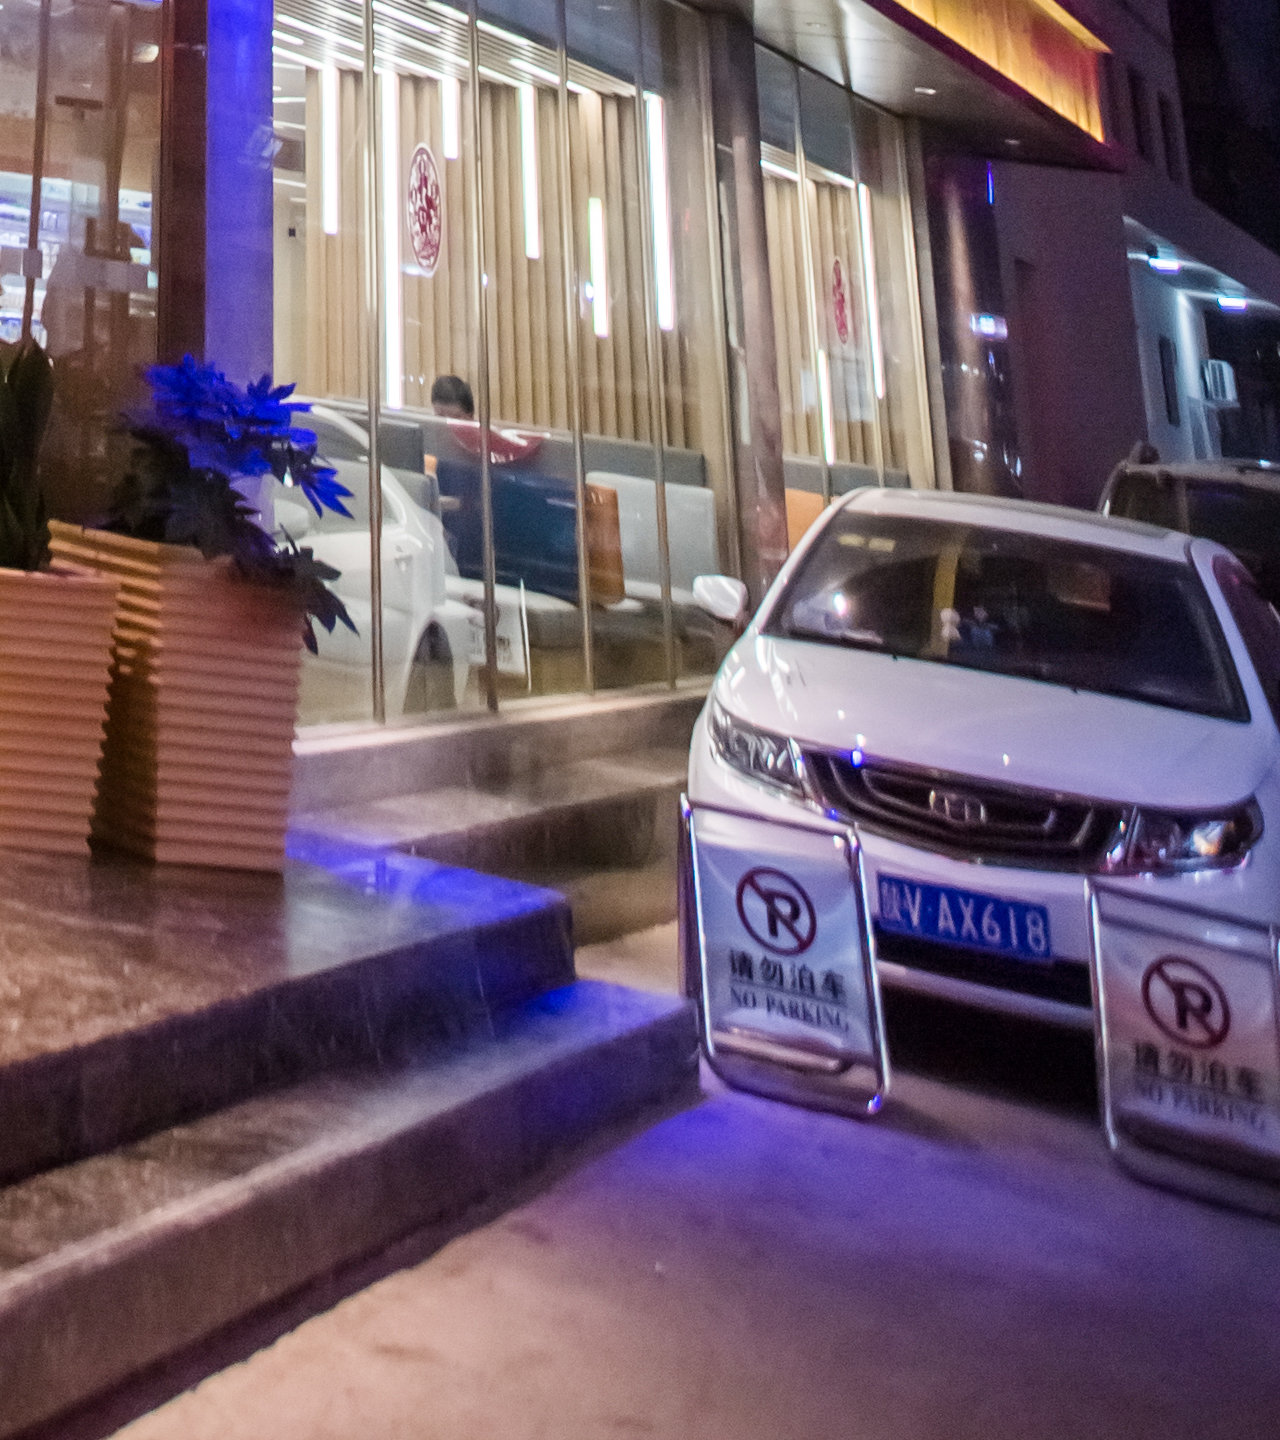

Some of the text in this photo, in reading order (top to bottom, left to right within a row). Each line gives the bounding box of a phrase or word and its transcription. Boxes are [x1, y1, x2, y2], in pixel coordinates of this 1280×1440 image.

[730, 949, 845, 1001] 请勿泊车
[730, 986, 850, 1033] NO PARKING
